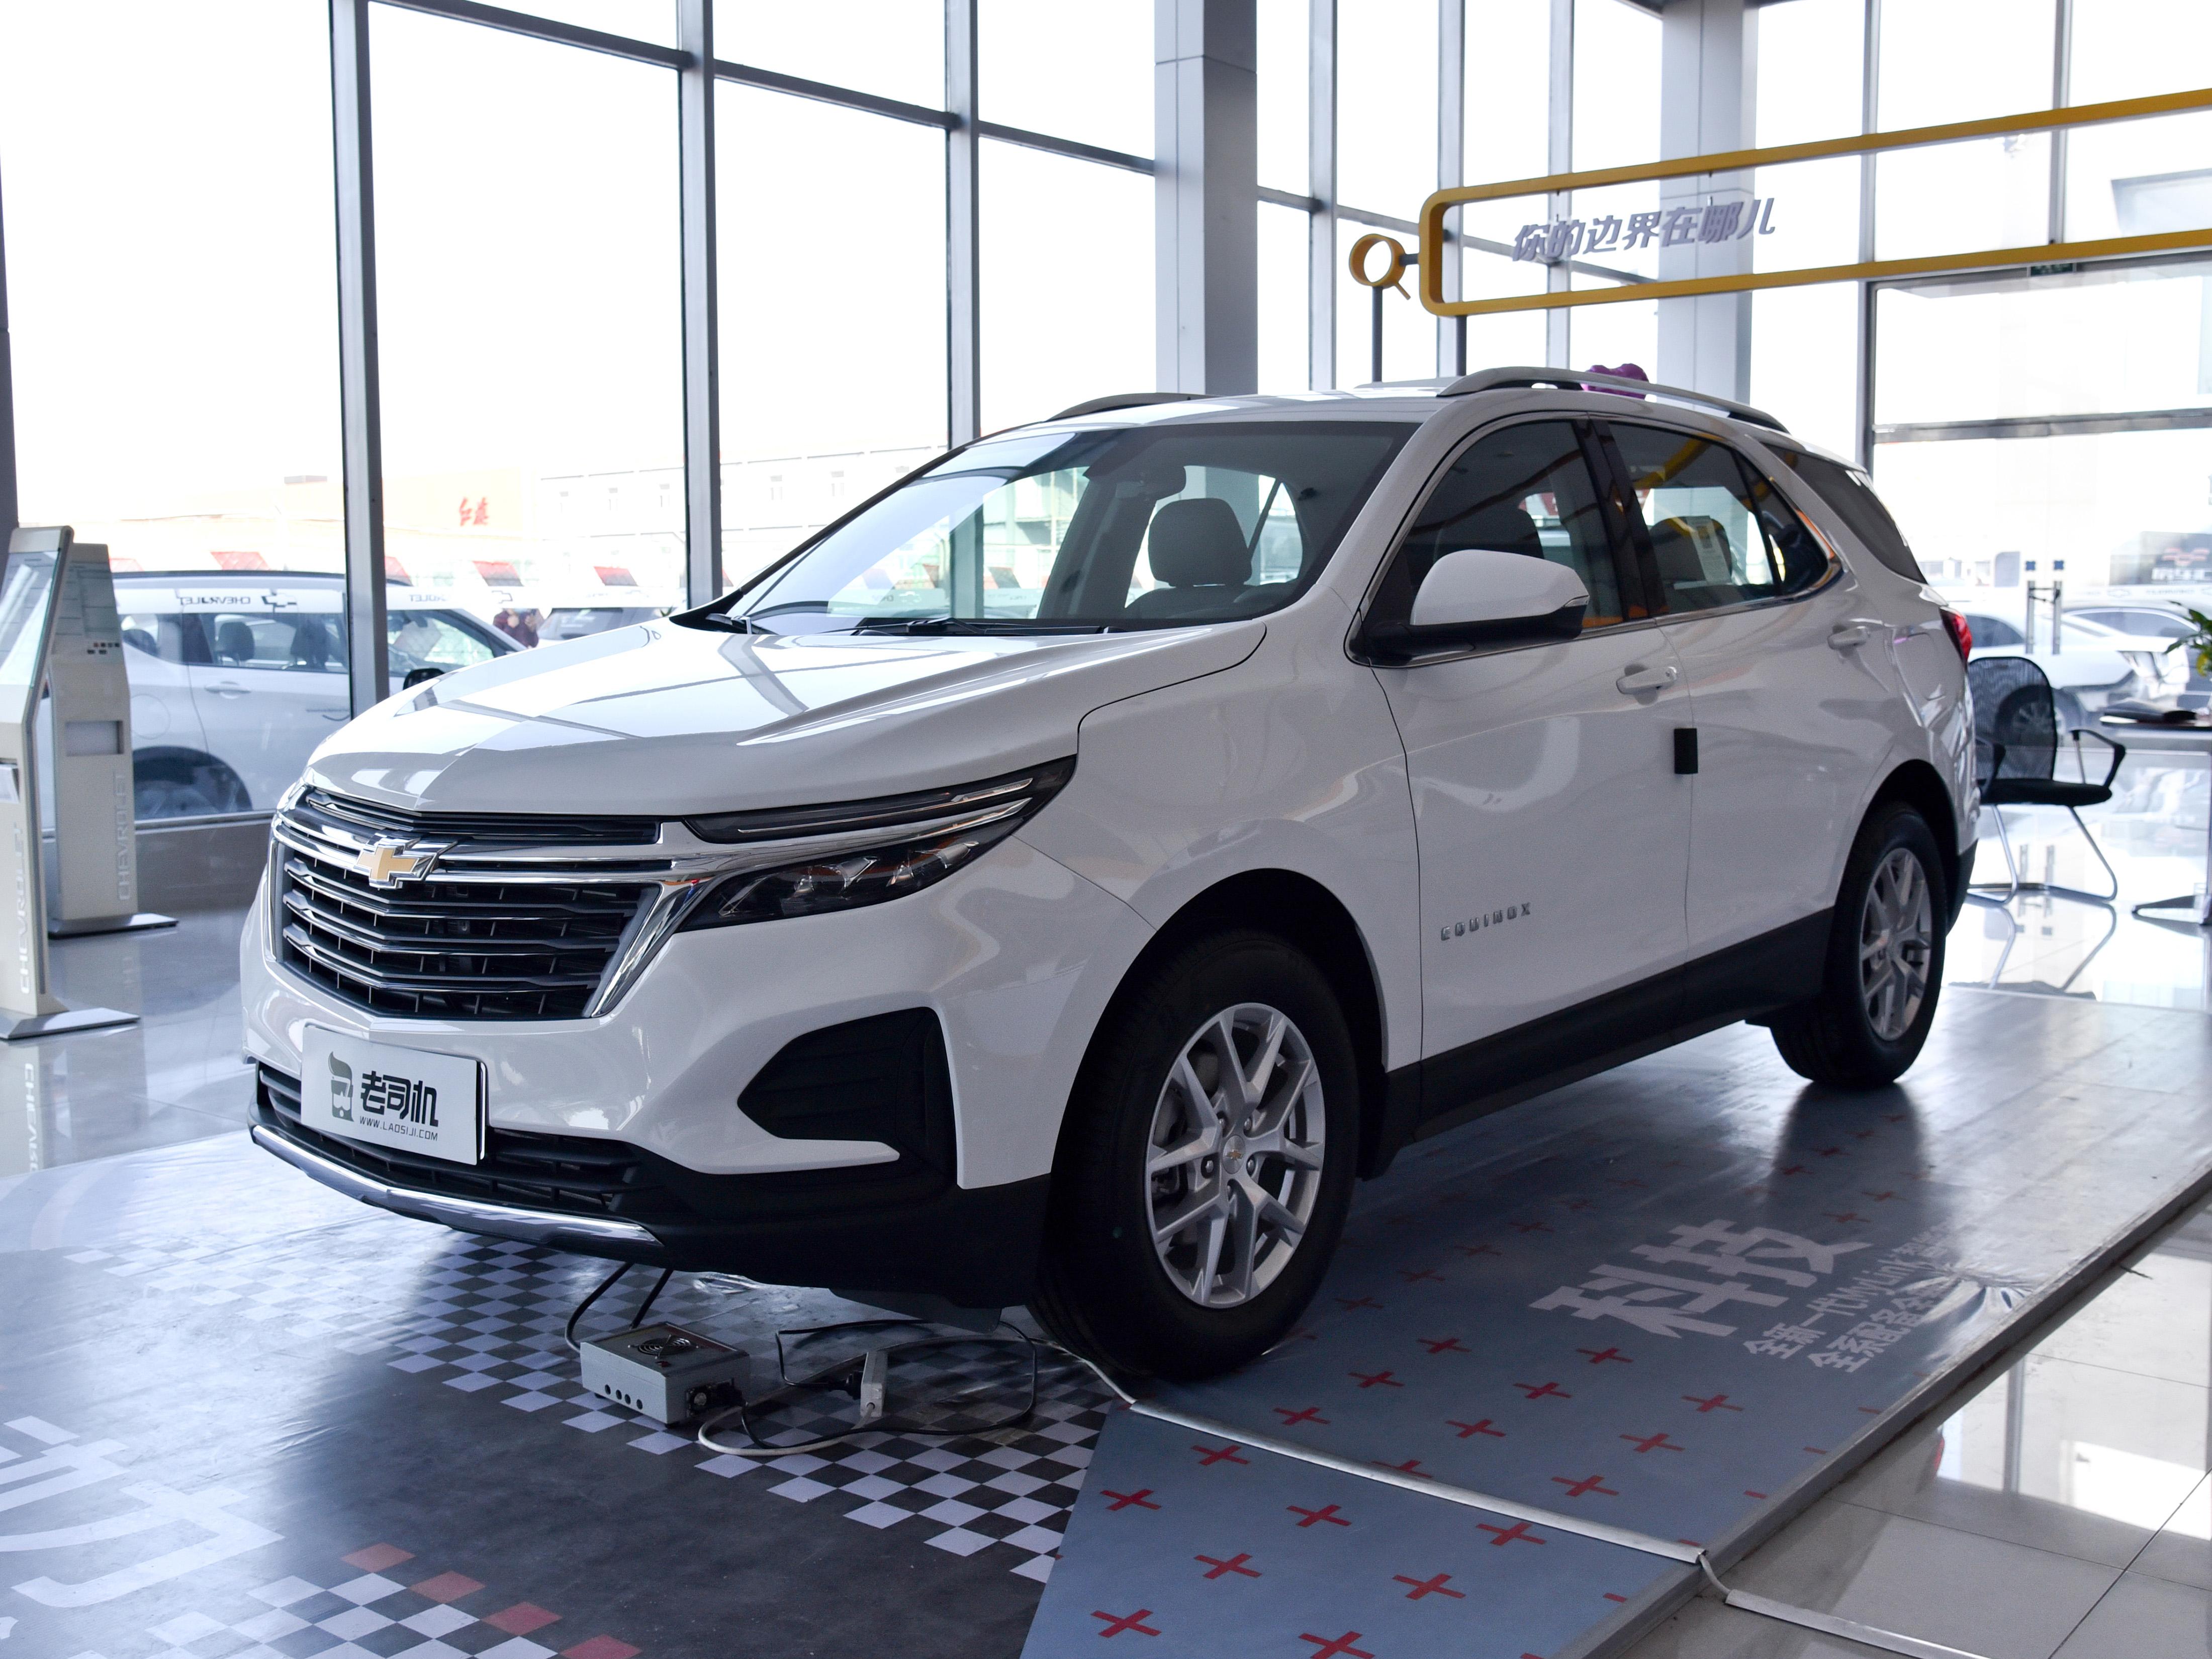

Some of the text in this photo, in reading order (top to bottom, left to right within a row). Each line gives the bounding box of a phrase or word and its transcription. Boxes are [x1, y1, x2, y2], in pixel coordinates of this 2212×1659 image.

[1512, 198, 1775, 261] 你的边界在哪儿
[1441, 902, 1531, 941] EQUINOX
[360, 1070, 439, 1127] 老司机
[359, 1116, 438, 1141] WWW.LAOSIJI.COM
[1528, 1219, 1874, 1338] 科技
